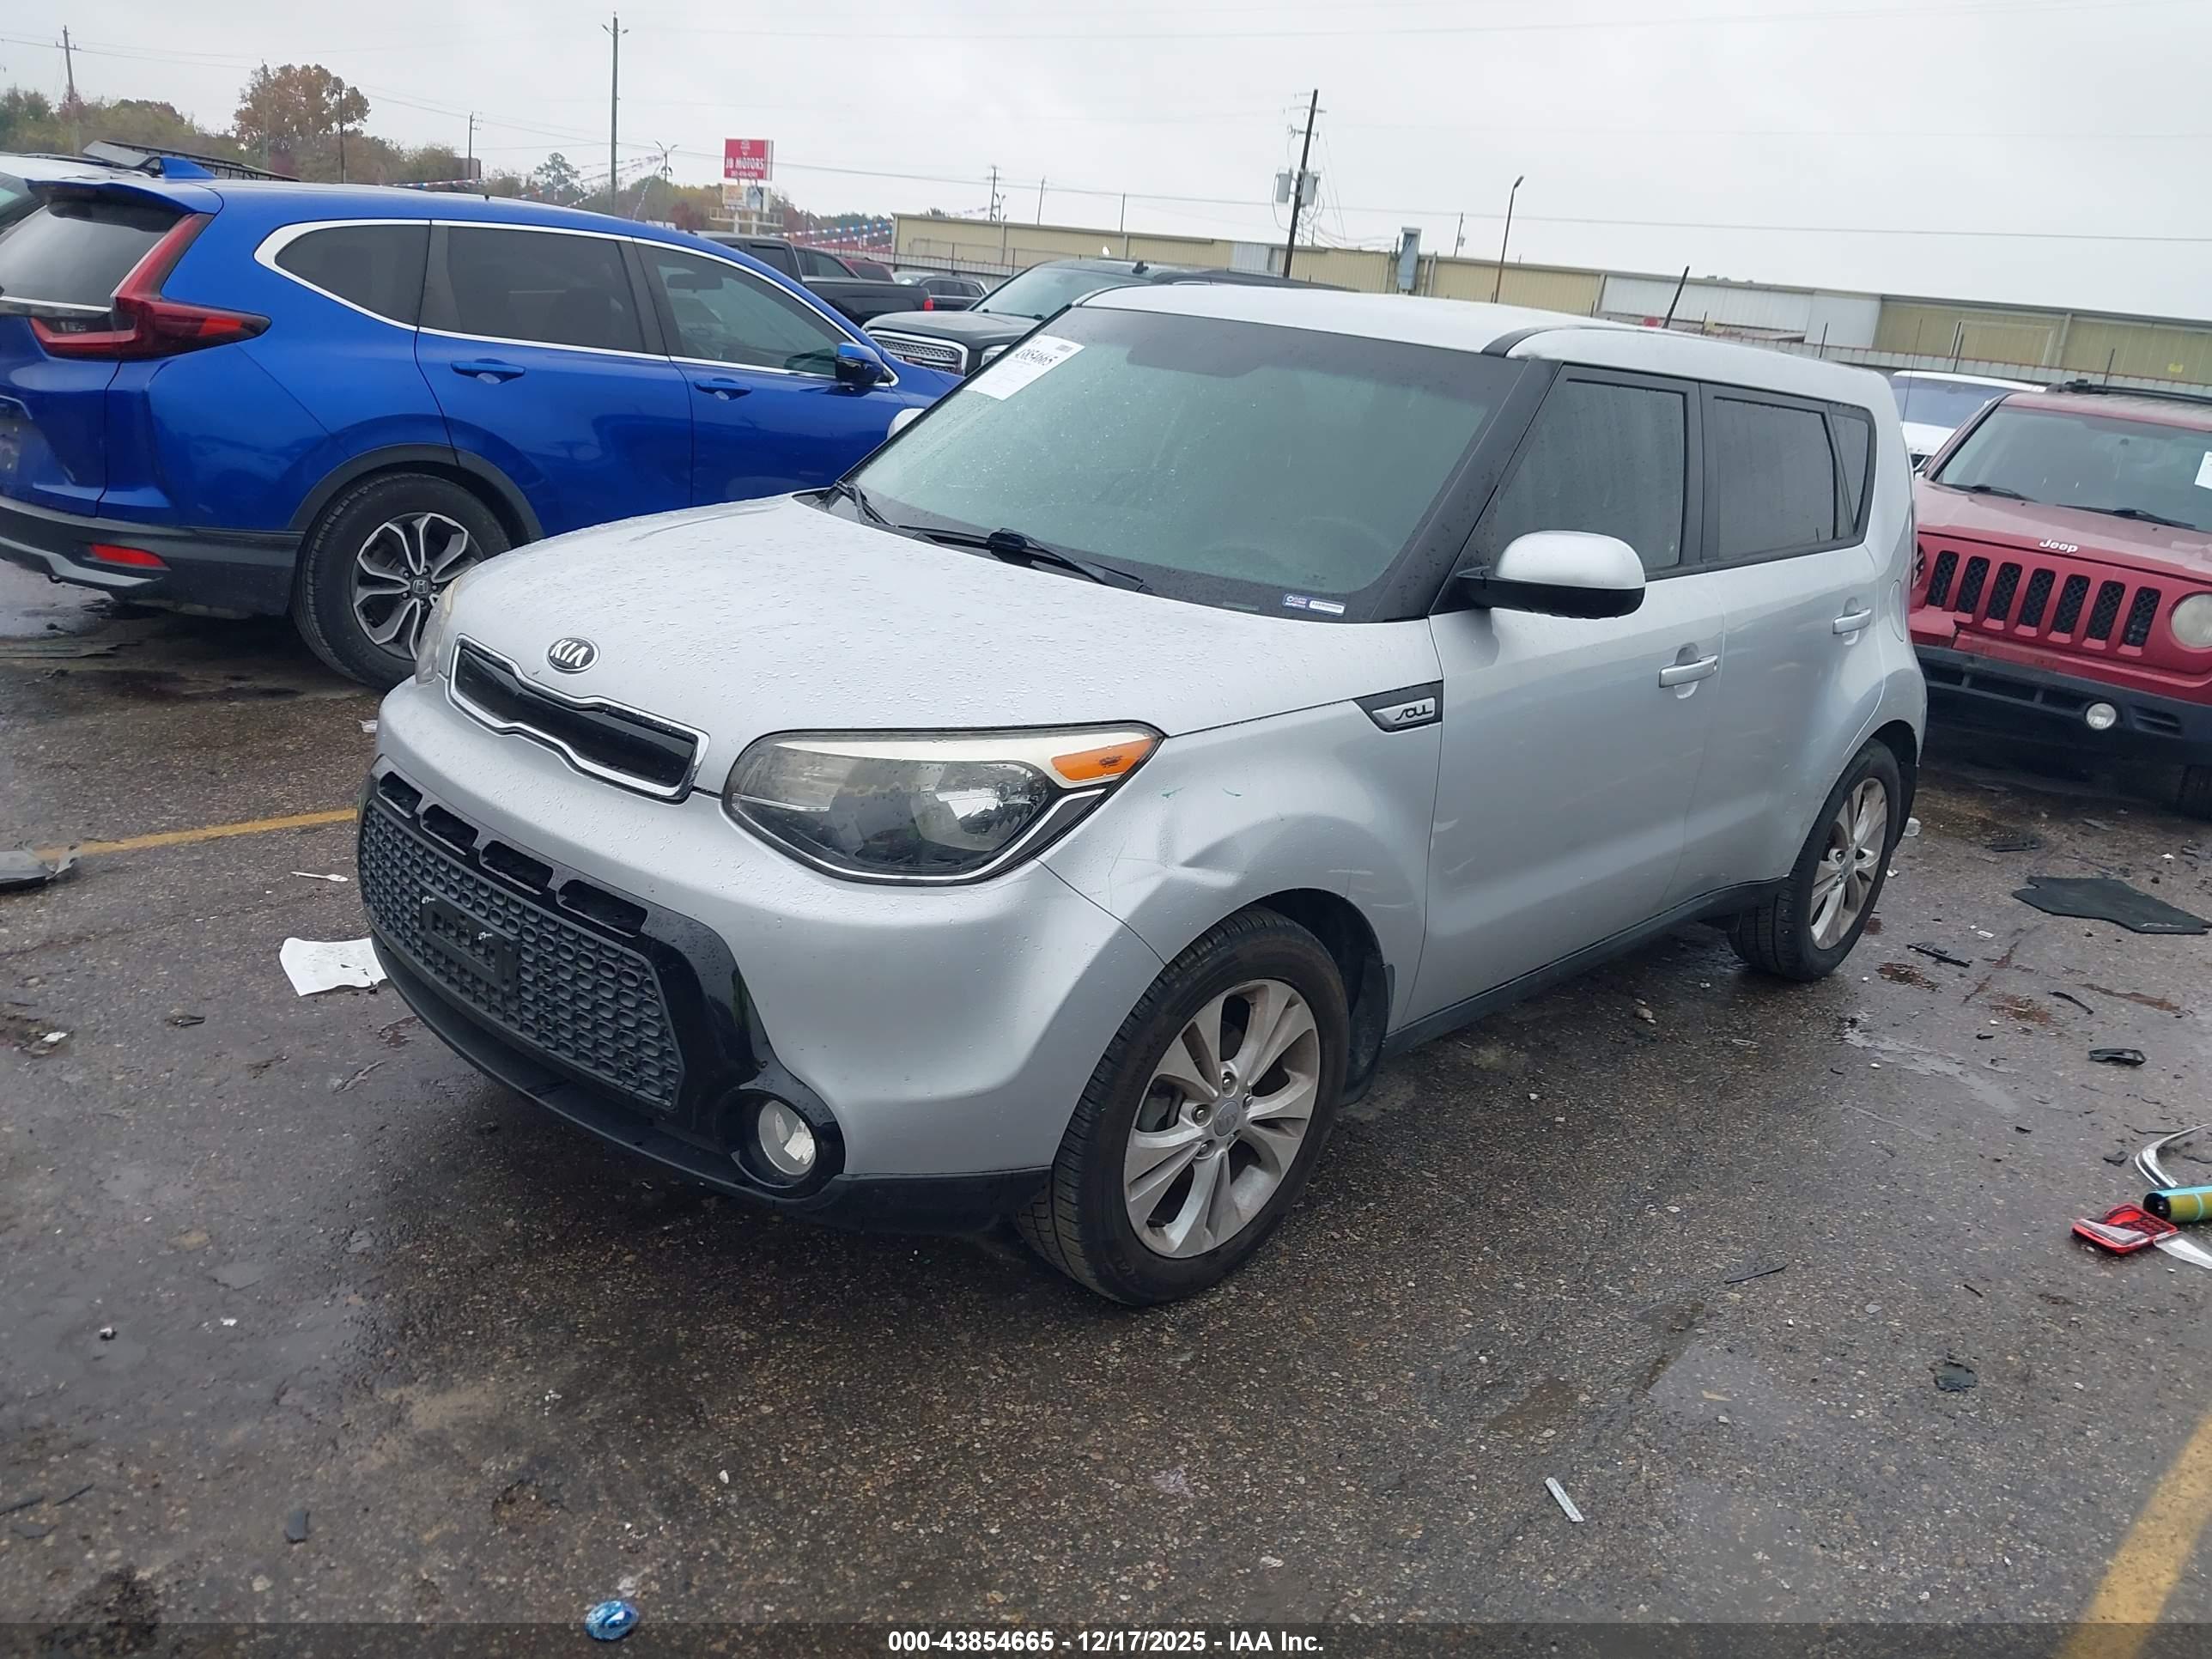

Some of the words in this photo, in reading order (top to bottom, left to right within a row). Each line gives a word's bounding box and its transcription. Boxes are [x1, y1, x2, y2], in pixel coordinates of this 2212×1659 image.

[735, 157, 764, 171] MOTORS
[2039, 539, 2078, 554] Jeep
[549, 639, 590, 668] KIA
